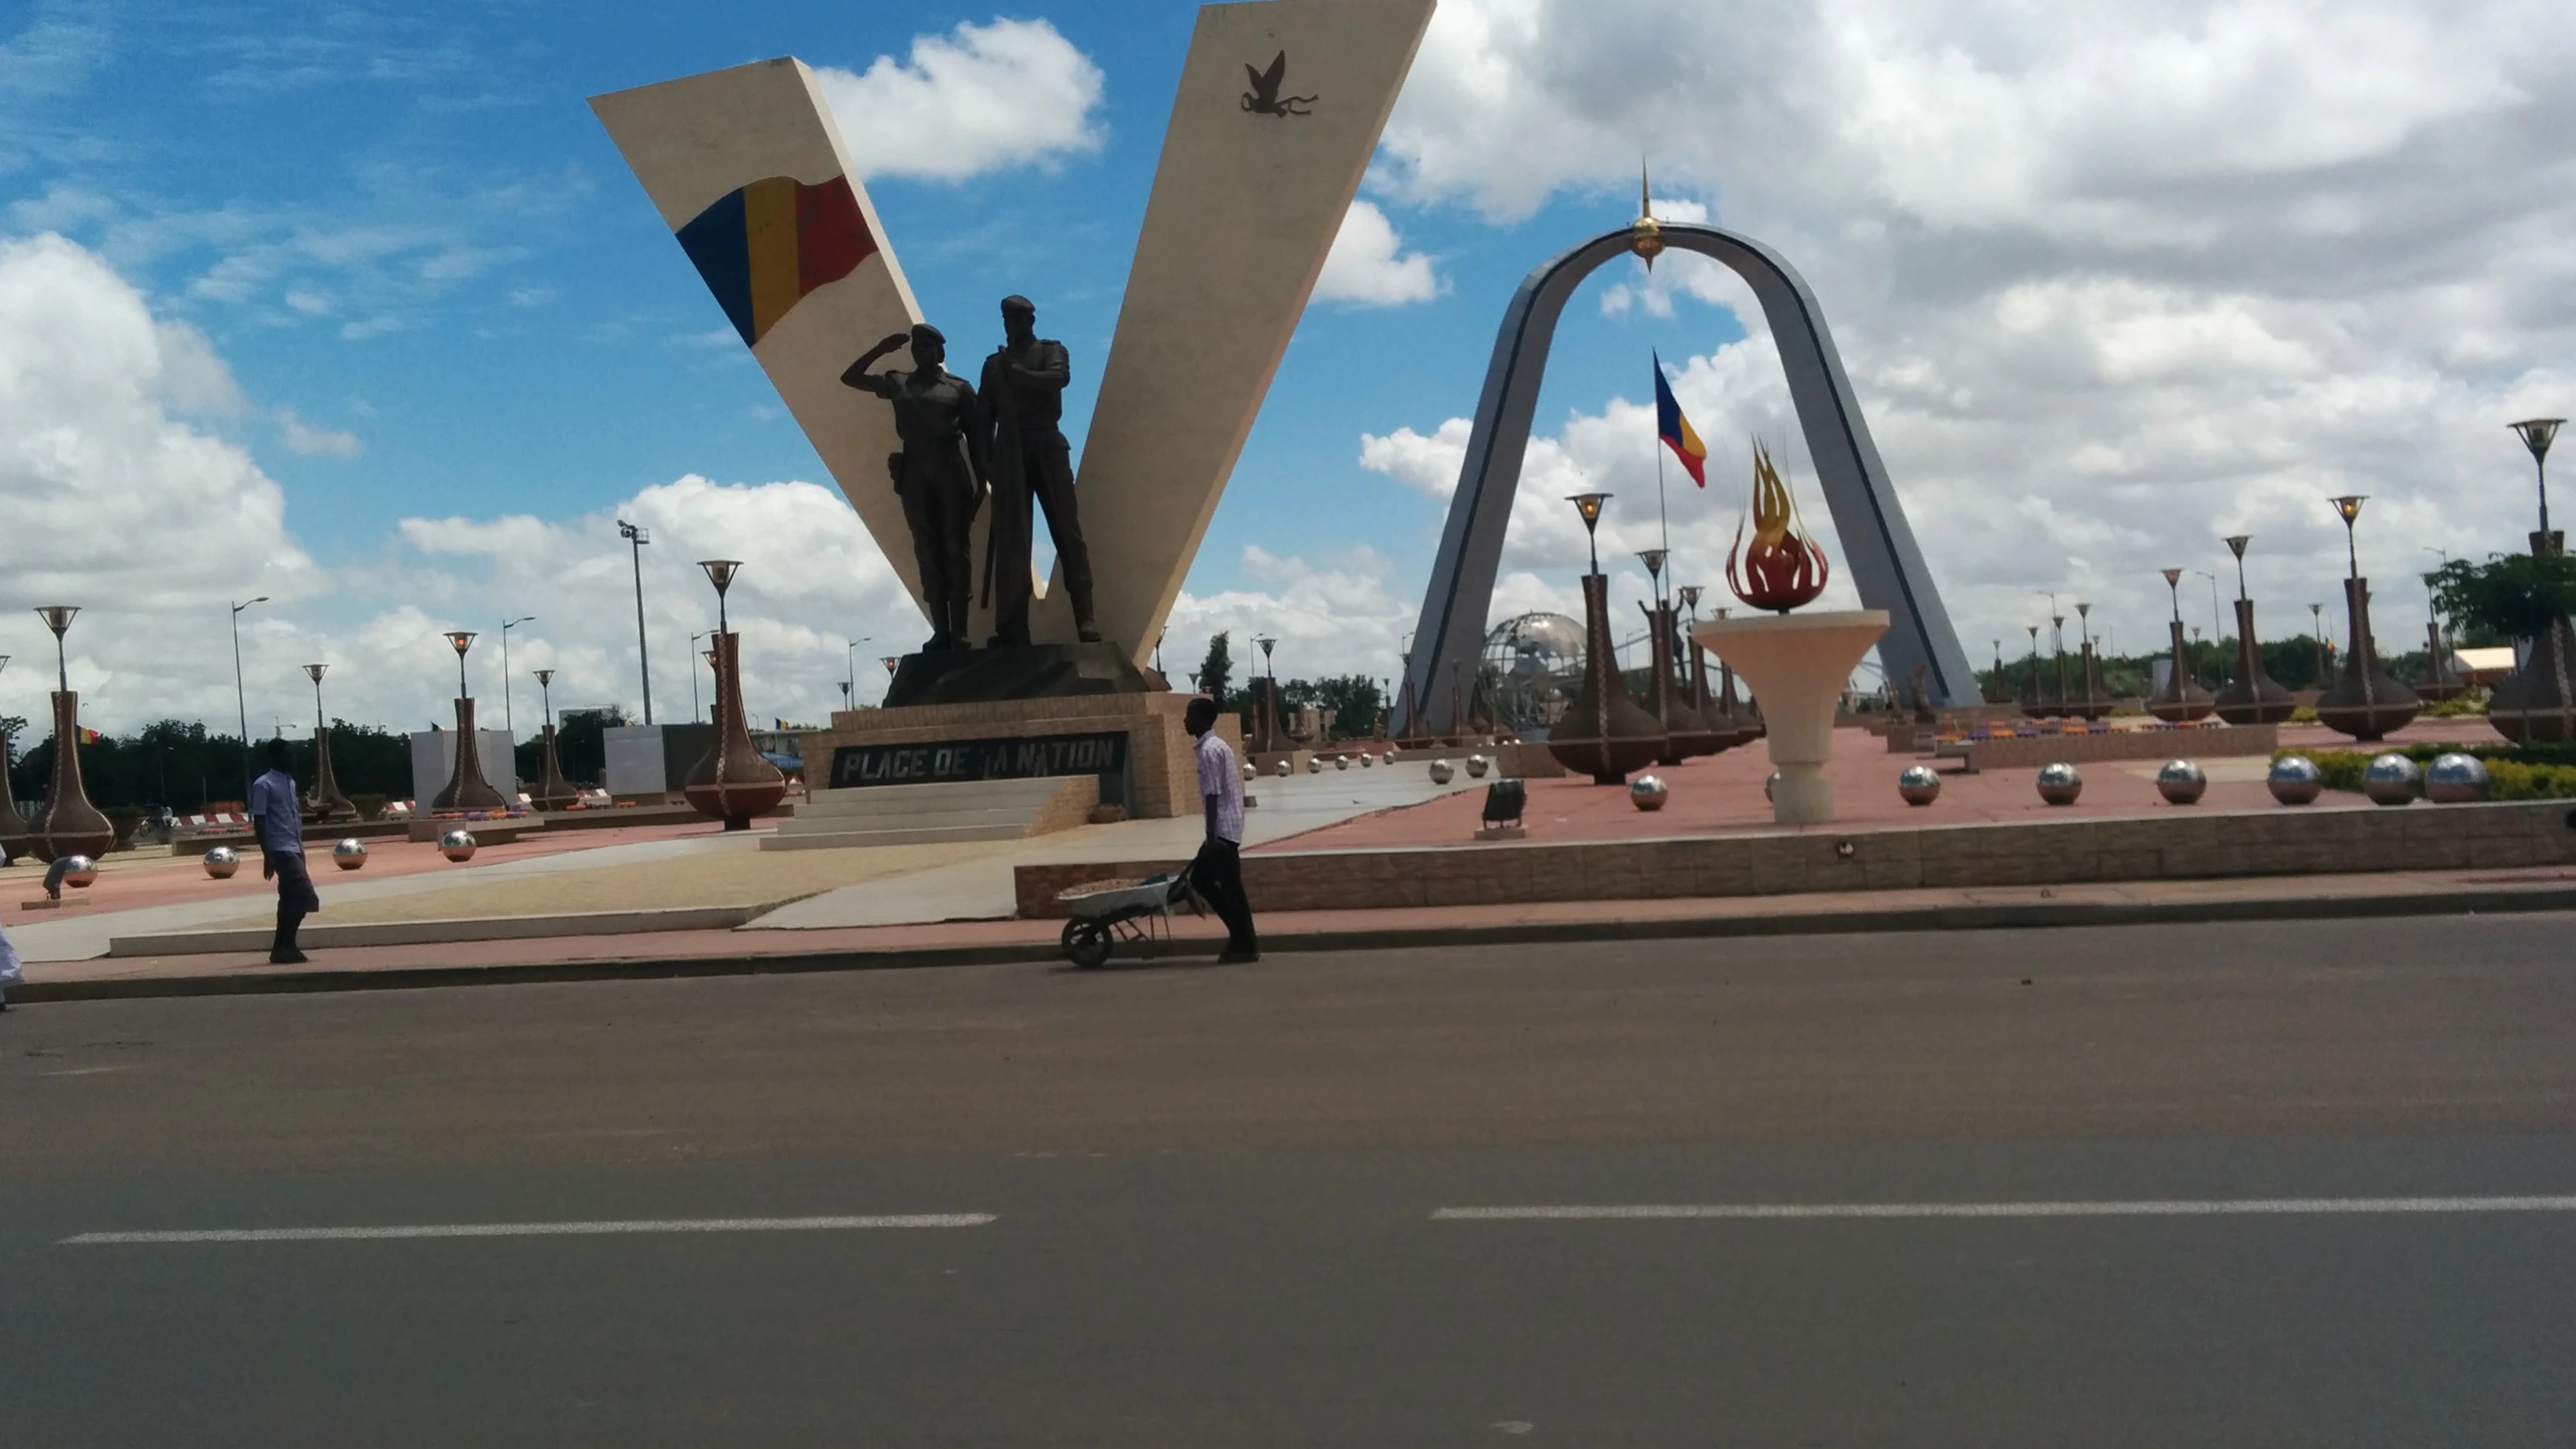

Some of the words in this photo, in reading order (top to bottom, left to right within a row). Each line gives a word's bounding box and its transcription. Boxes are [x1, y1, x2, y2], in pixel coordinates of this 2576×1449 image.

[842, 749, 928, 782] PLACE
[933, 747, 971, 776] DE
[1016, 738, 1114, 777] NATION
